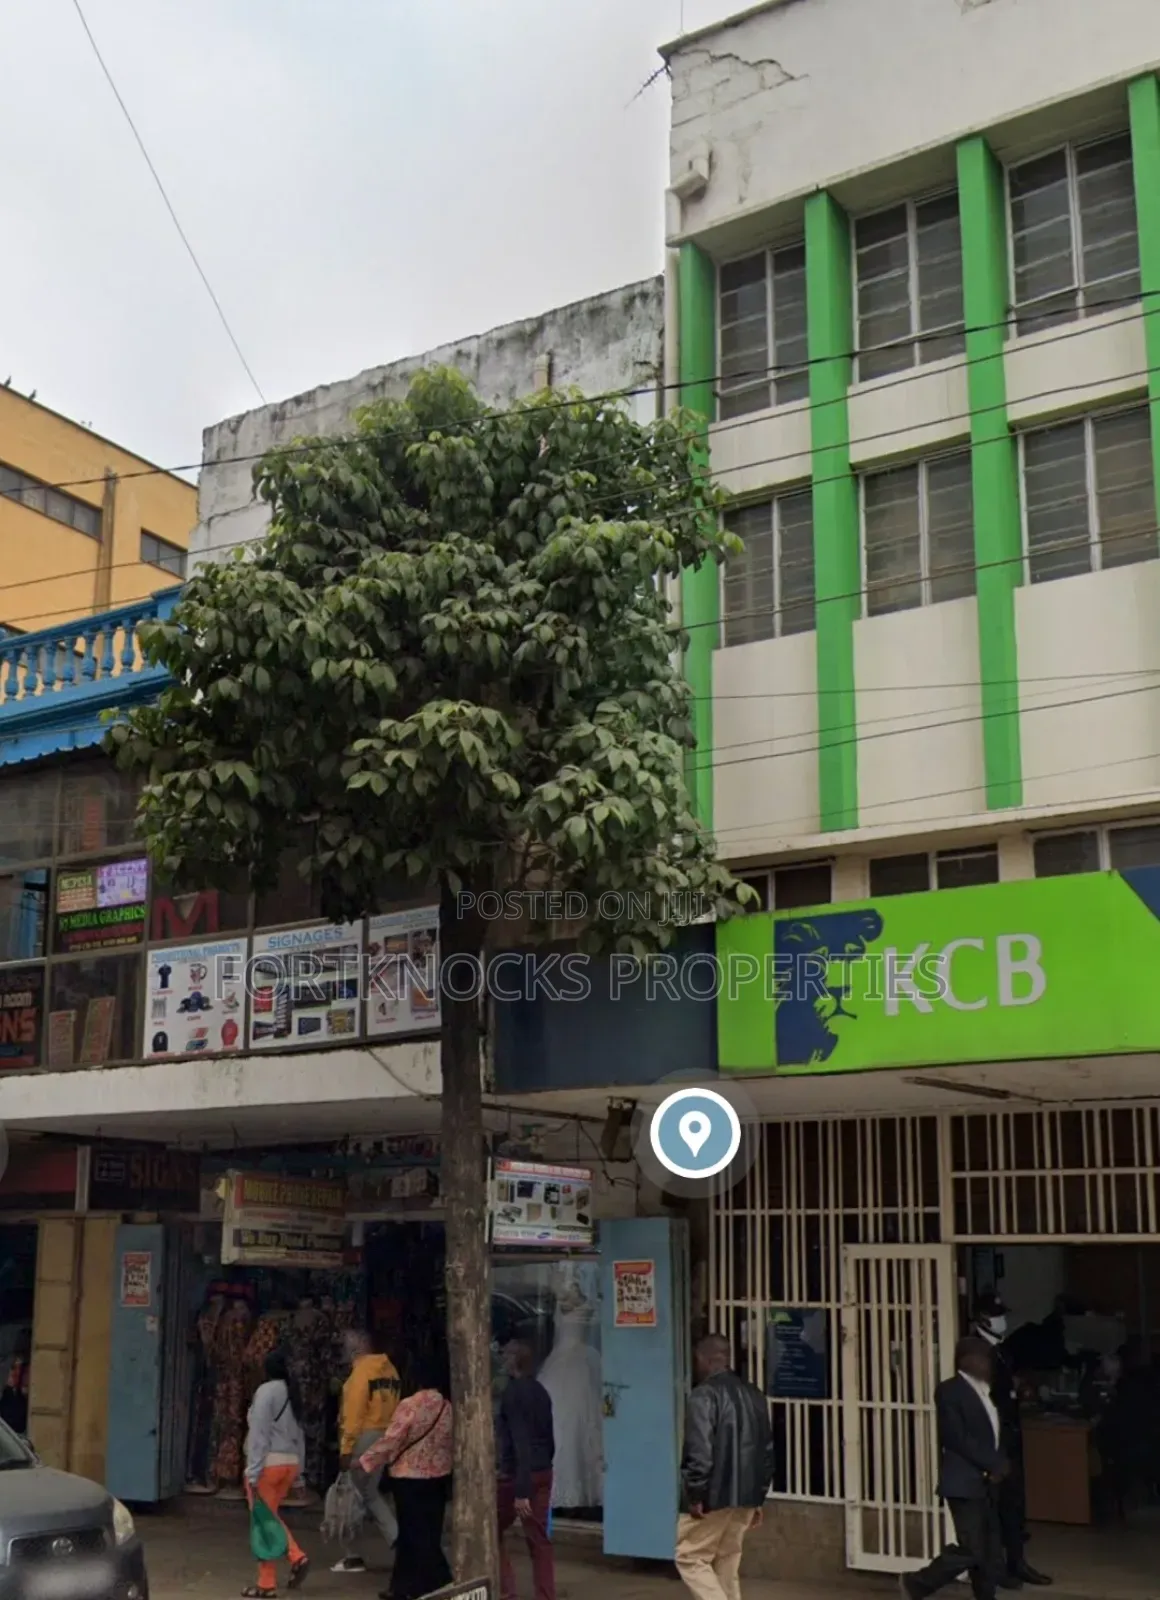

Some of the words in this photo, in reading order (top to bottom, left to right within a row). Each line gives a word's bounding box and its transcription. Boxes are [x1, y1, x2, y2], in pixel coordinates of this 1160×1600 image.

[99, 905, 146, 924] GRAPHICS
[268, 927, 344, 949] SIGNAGES
[883, 933, 1047, 1016] KCB
